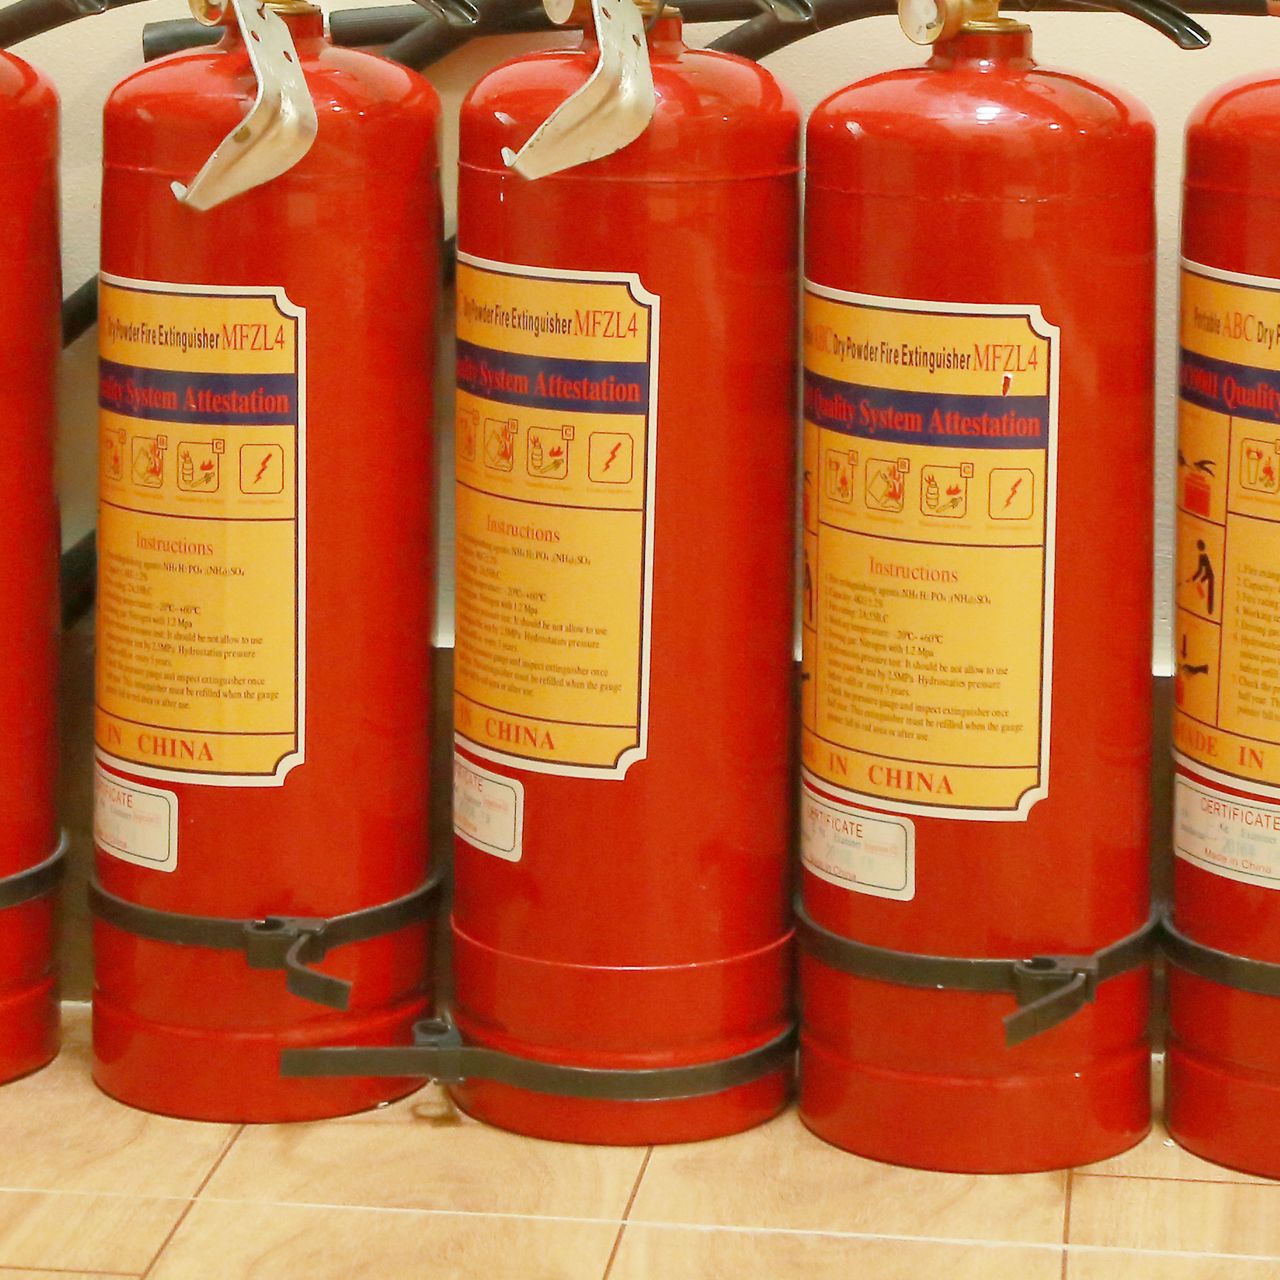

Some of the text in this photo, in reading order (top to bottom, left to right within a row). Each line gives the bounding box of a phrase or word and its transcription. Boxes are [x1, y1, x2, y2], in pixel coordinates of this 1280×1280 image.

[141, 323, 156, 345] Fire
[159, 325, 219, 353] Extinguisher
[222, 323, 284, 351] MFZL4
[512, 307, 572, 338] Extinguisher
[574, 309, 638, 339] MFZL4
[1223, 312, 1255, 341] ABC
[1257, 321, 1275, 350] Dry
[847, 336, 878, 361] Powder
[880, 341, 899, 364] Fire
[902, 343, 971, 374] Extinguisher
[973, 343, 1038, 372] MFZL4
[184, 386, 290, 414] Attestation
[534, 371, 641, 402] Attestation
[859, 399, 923, 434] System
[928, 408, 1041, 437] Attestation
[486, 514, 560, 542] Instructions
[136, 531, 214, 556] Instructions
[870, 556, 959, 583] Instructions
[137, 733, 214, 762] CHINA
[485, 718, 555, 750] CHINA
[1238, 745, 1265, 770] IN
[829, 752, 848, 776] IN
[868, 764, 954, 795] CHINA
